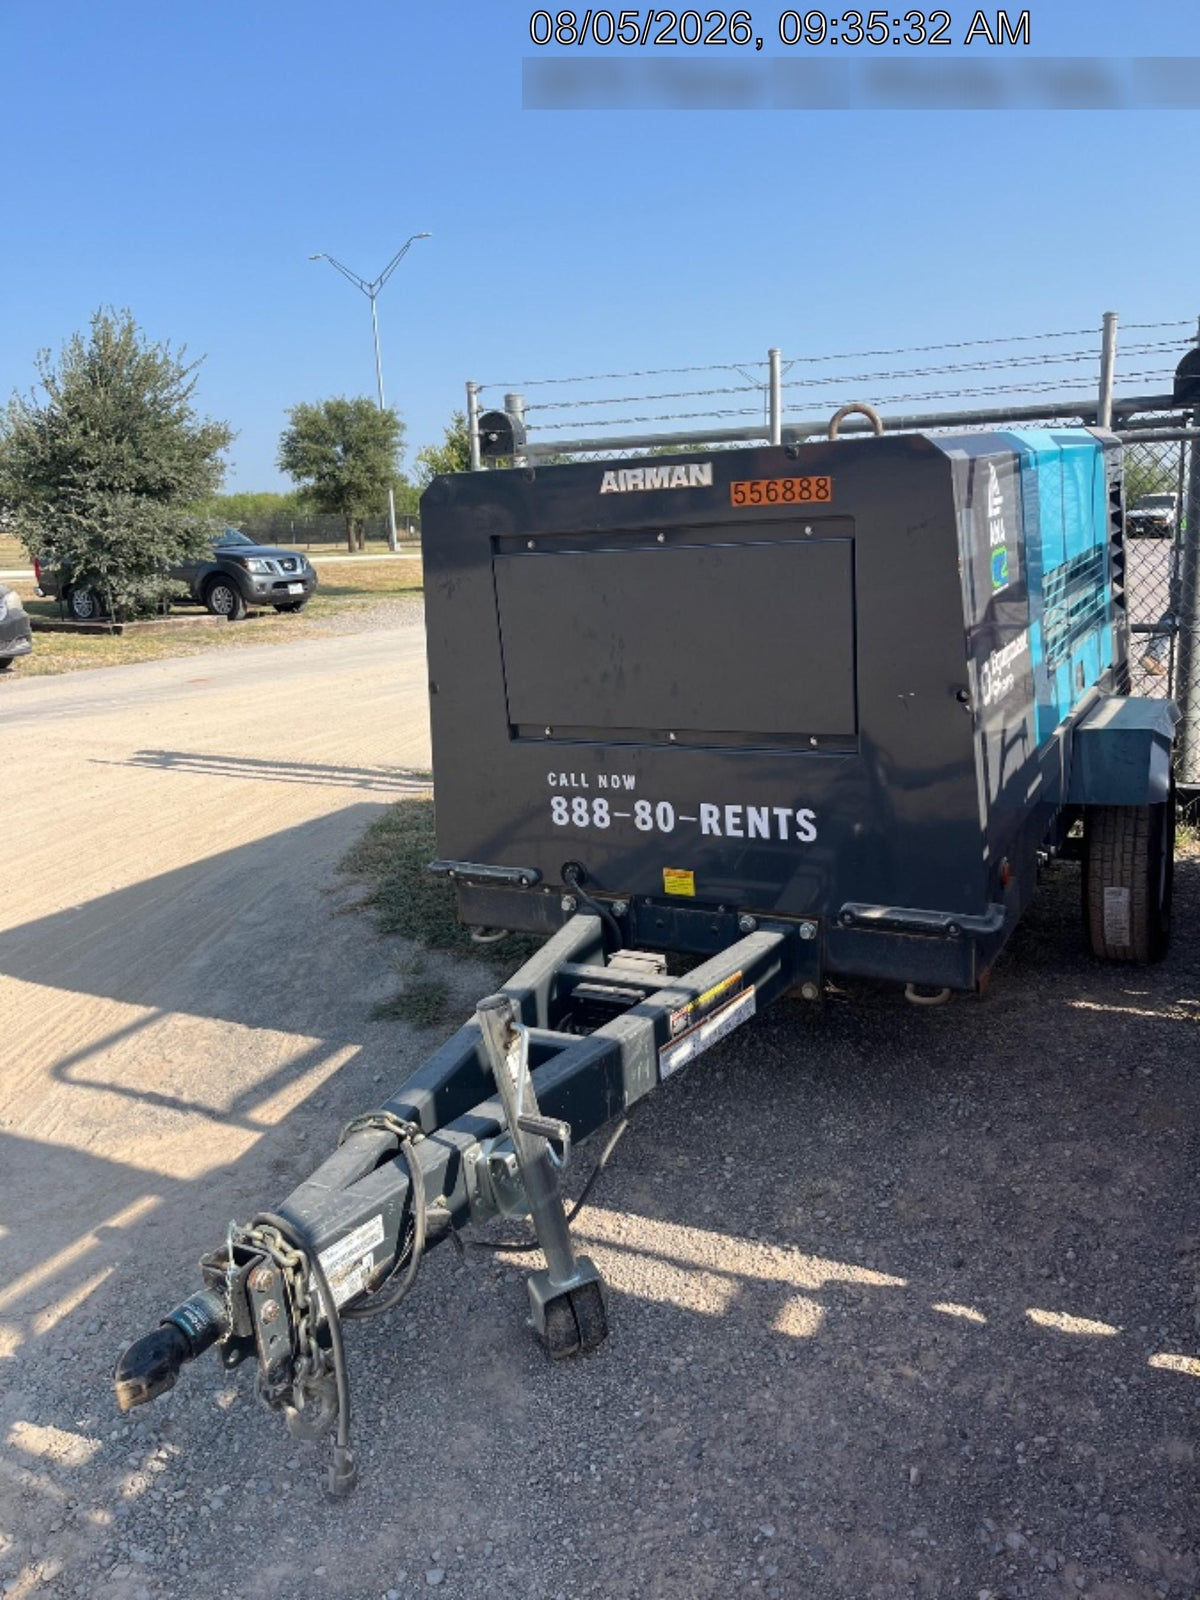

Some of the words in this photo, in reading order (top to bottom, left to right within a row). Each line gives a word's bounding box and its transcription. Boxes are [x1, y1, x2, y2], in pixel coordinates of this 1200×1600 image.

[600, 462, 713, 494] AIRMAN
[734, 478, 829, 504] 556888
[547, 772, 589, 788] CALL
[597, 774, 637, 791] NOW
[550, 795, 818, 843] 888-80-RENTS
